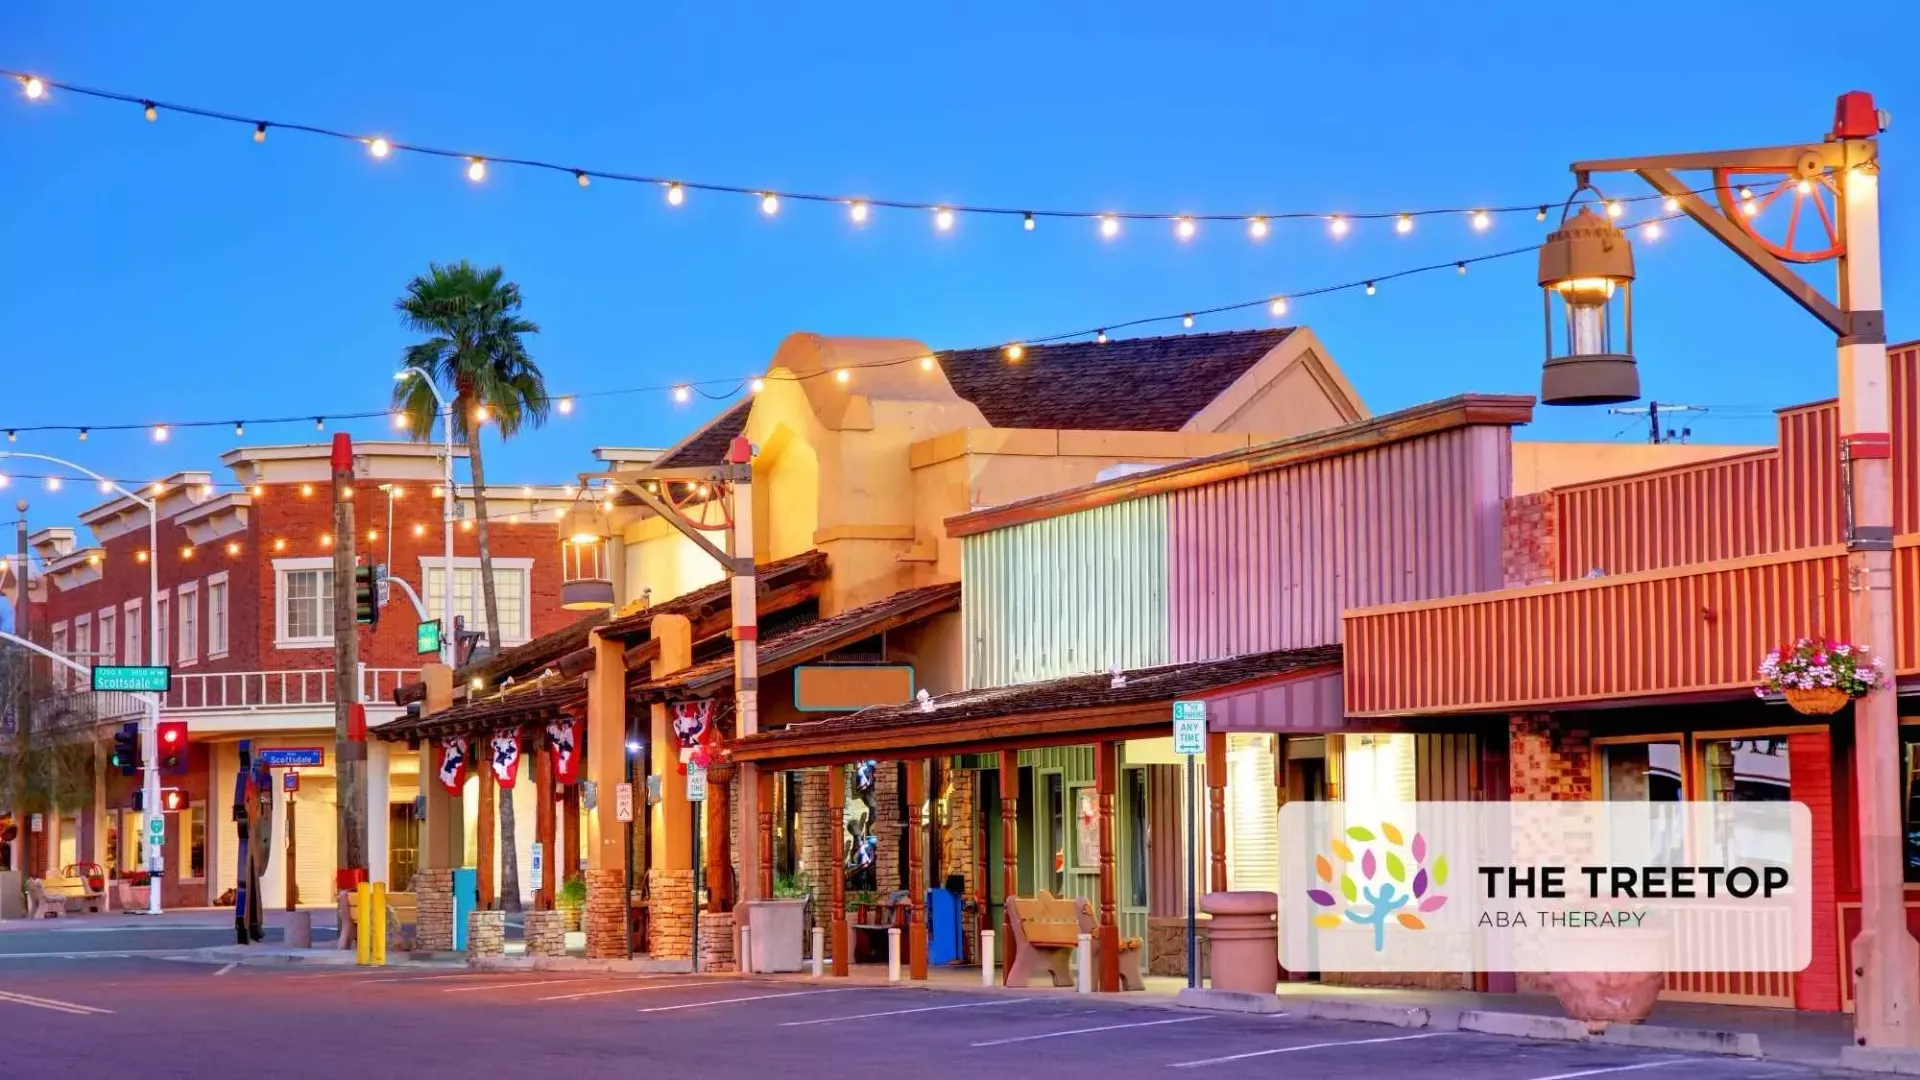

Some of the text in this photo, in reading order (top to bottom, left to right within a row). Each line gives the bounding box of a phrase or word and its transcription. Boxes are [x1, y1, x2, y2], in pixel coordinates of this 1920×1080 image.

[98, 678, 165, 689] Scottsdale Rd
[1175, 703, 1182, 719] 3
[1181, 722, 1198, 731] ANY
[1180, 733, 1199, 742] TIME
[270, 756, 312, 764] Scottsdale
